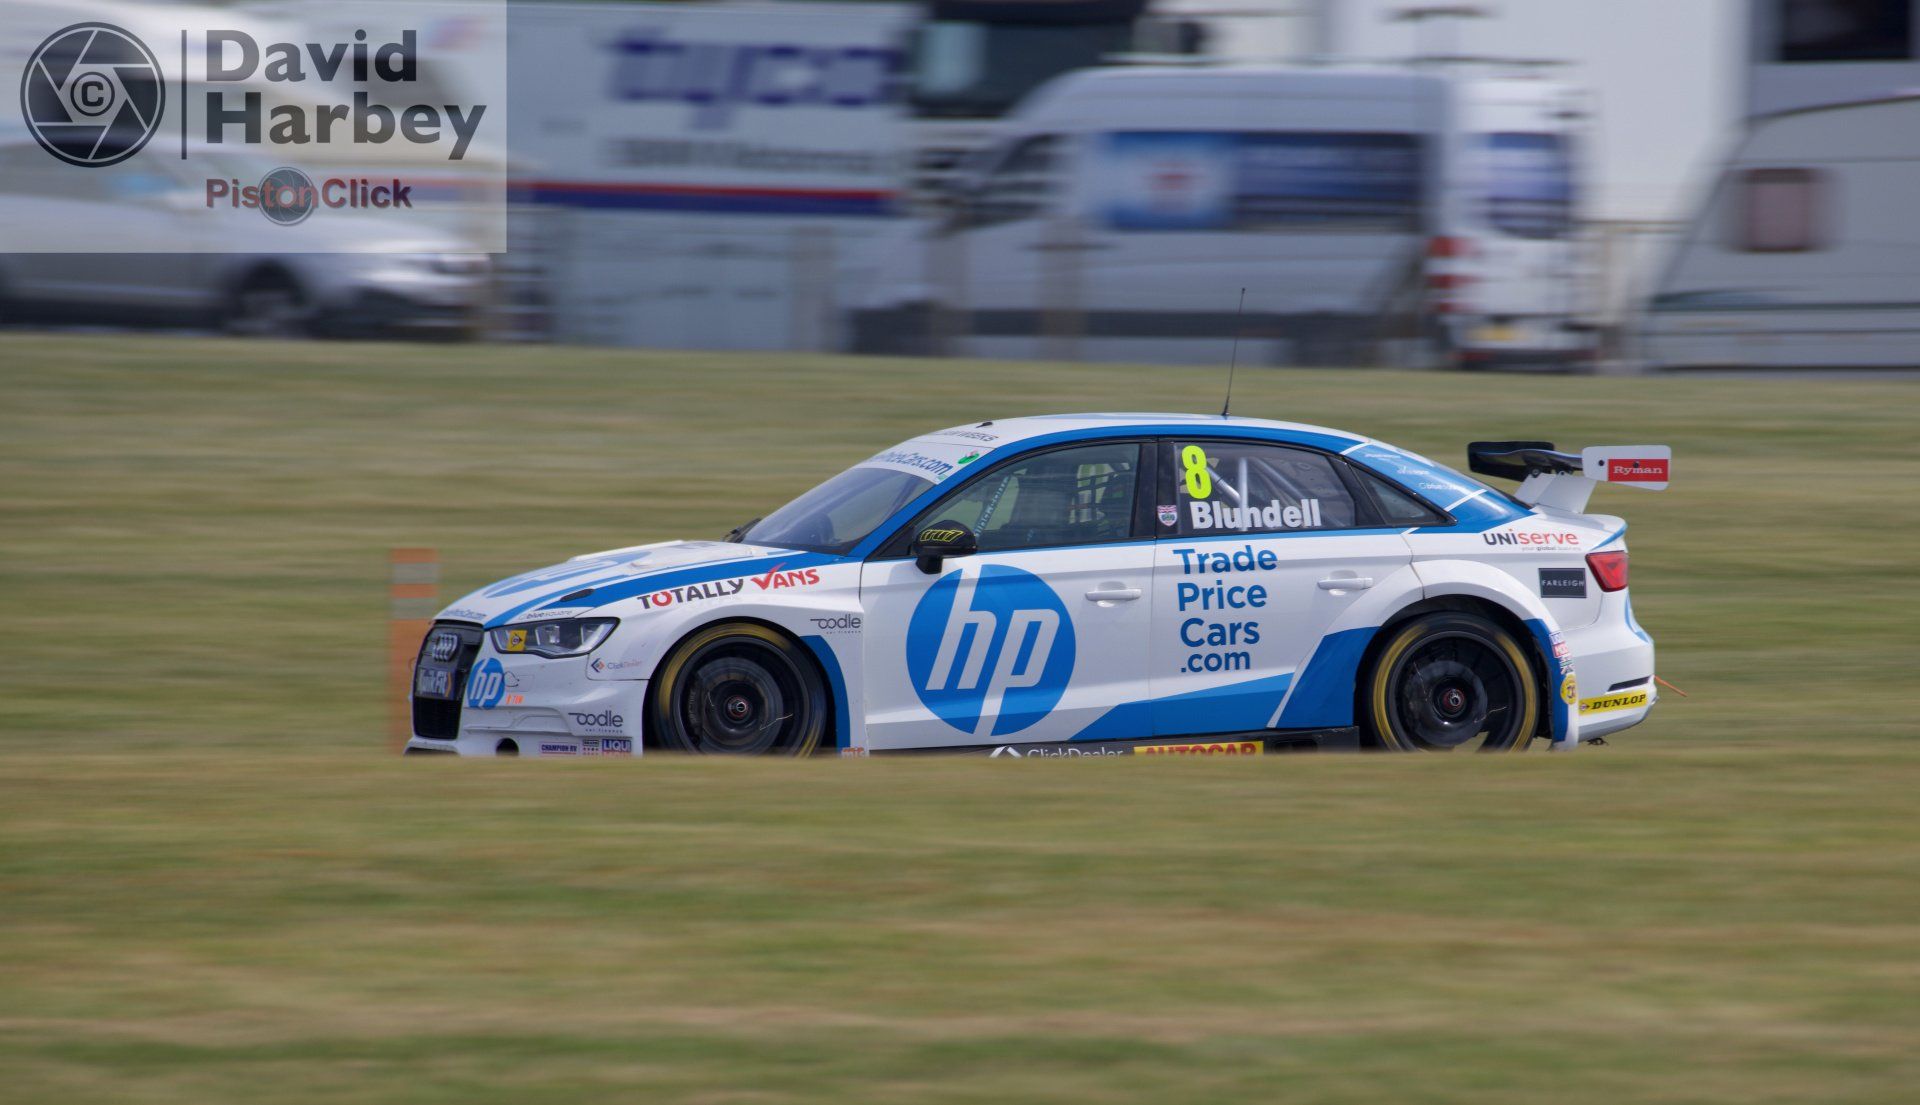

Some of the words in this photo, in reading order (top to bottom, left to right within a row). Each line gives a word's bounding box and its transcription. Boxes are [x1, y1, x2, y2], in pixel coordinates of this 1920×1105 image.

[1182, 445, 1212, 499] 8
[1612, 465, 1663, 475] Ryman
[1189, 498, 1322, 530] Blundell
[1173, 545, 1278, 575] Trade
[637, 578, 744, 610] TOTALLY
[750, 562, 820, 590] VANS
[1177, 579, 1268, 612] Price
[810, 613, 862, 629] oodle
[1180, 617, 1260, 648] Cars
[923, 562, 1061, 736] hp
[1181, 651, 1251, 673] .com
[470, 657, 503, 706] hp
[1592, 694, 1646, 709] DUNLOP
[568, 710, 624, 727] oodle
